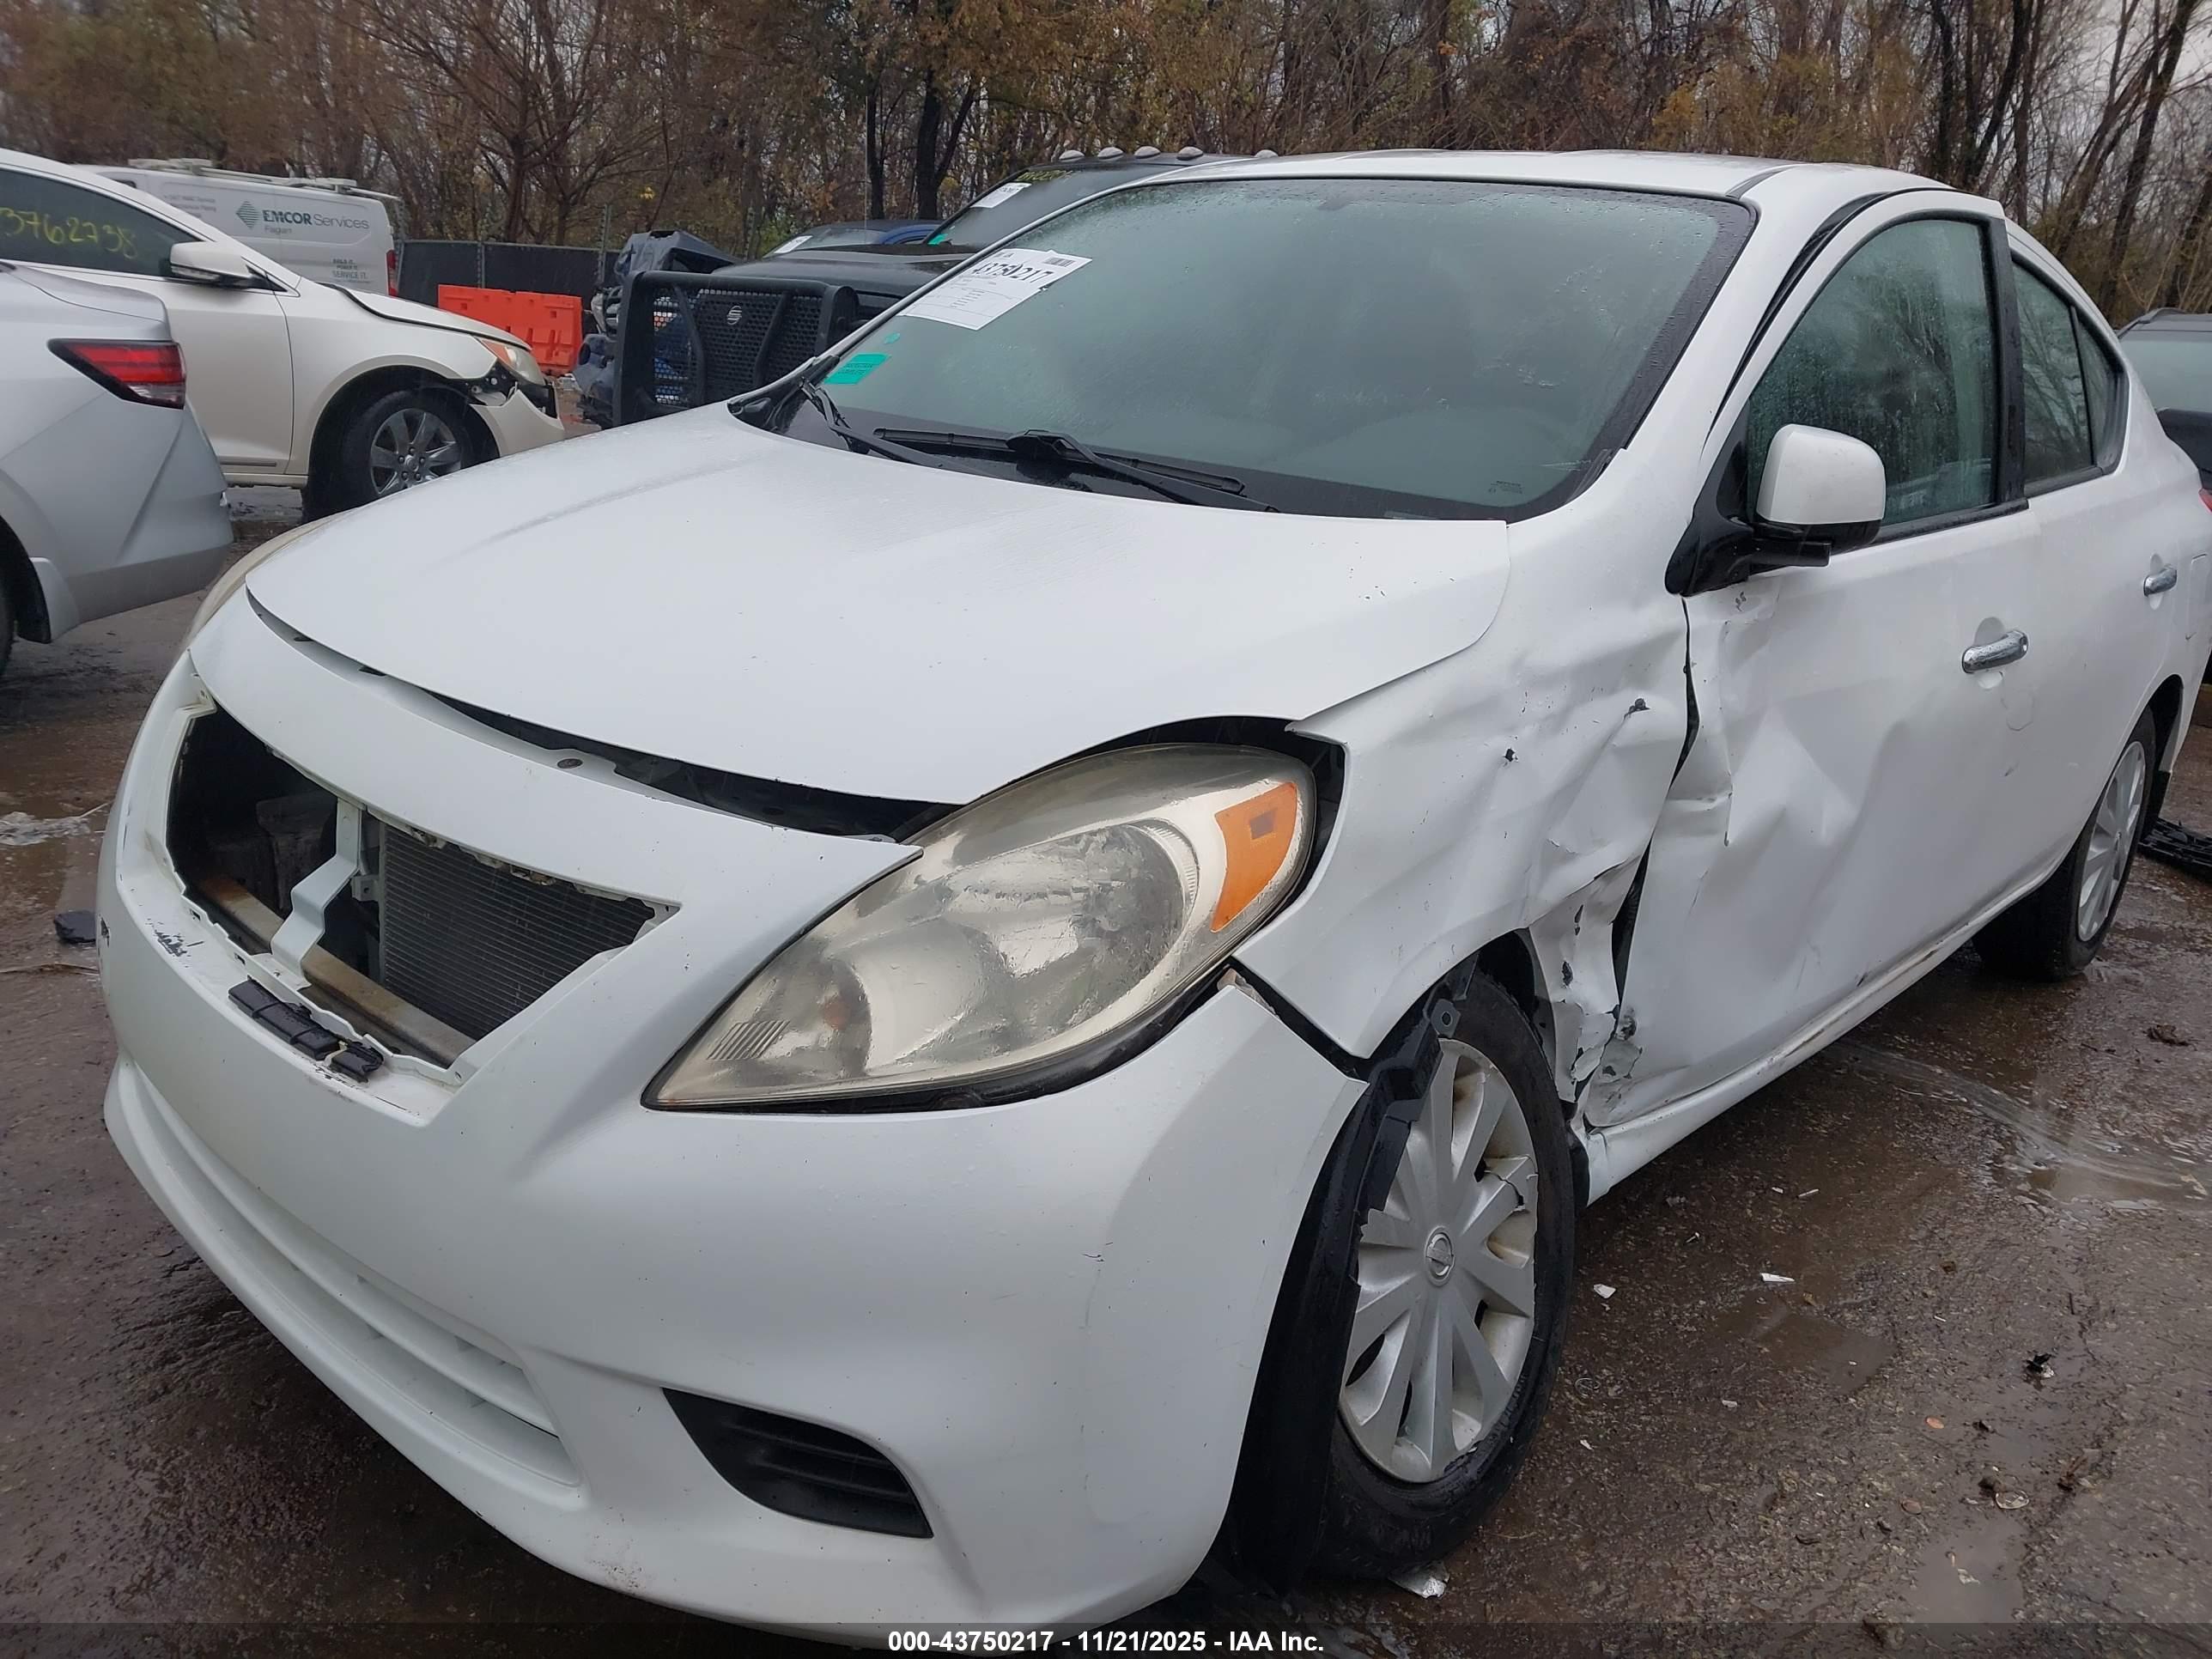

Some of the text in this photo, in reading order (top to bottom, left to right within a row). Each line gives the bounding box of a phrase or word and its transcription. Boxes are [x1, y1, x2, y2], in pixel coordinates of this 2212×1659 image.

[262, 210, 370, 229] EMCOR Services
[331, 270, 358, 279] SERVICE
